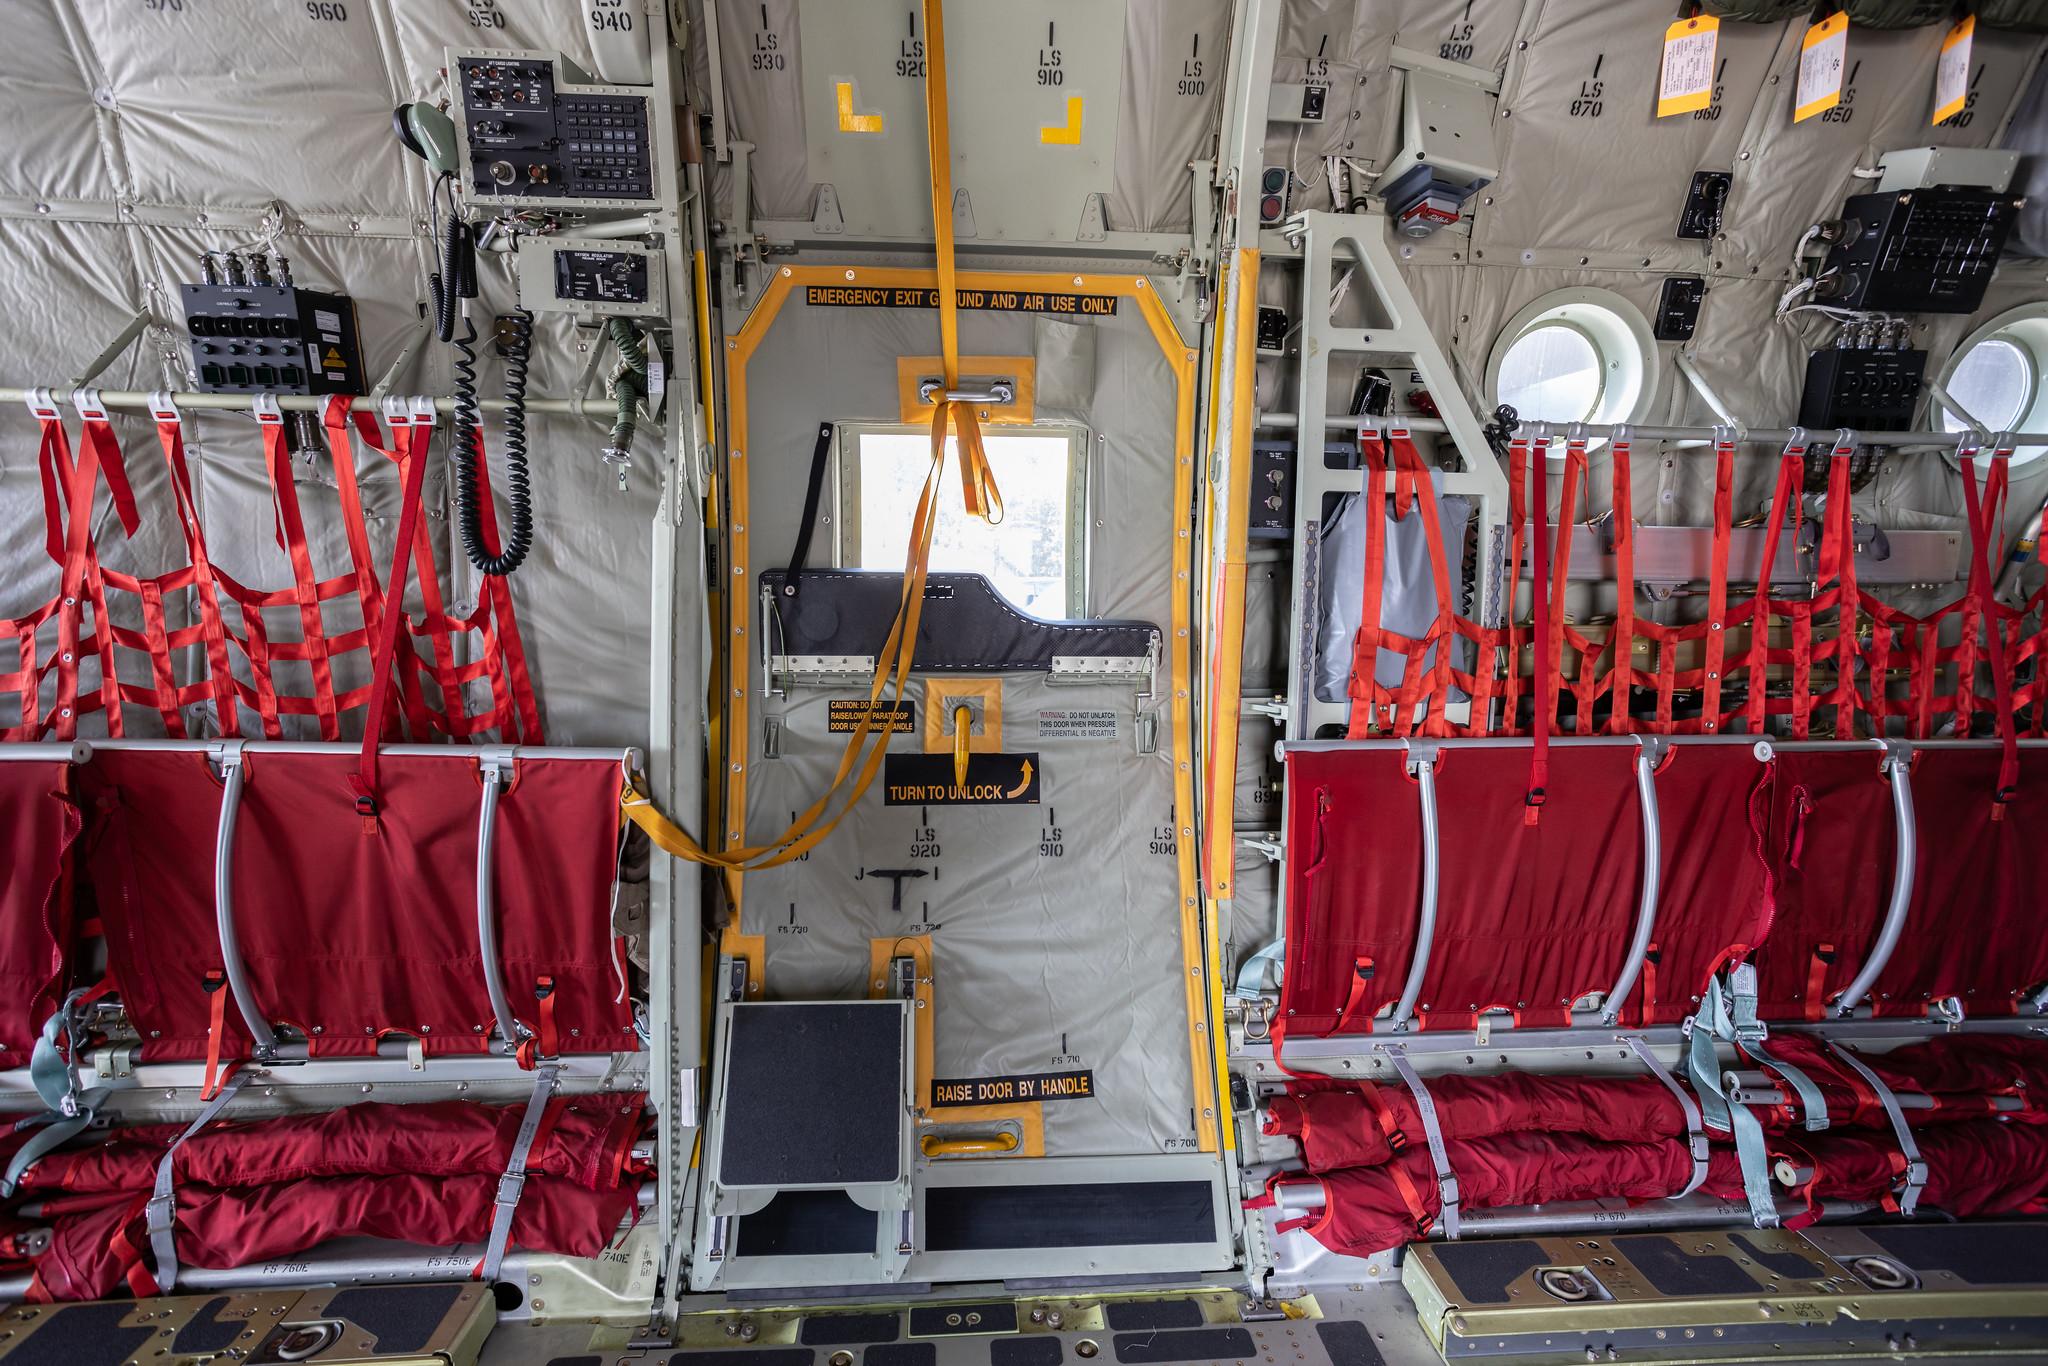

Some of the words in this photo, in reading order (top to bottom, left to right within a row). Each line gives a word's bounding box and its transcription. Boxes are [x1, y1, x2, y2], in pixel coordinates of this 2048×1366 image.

[306, 2, 347, 22] 960
[468, 10, 505, 29] 950
[592, 10, 632, 32] 940
[1450, 25, 1474, 41] LS
[756, 34, 777, 50] LS
[902, 40, 922, 58] LS
[1040, 50, 1061, 66] LS
[1440, 44, 1474, 60] 880
[752, 54, 784, 71] 930
[1184, 61, 1202, 77] LS
[1306, 58, 1328, 76] LS
[1038, 70, 1063, 86] 910
[1178, 81, 1204, 96] 900
[1580, 81, 1604, 98] LS
[1570, 101, 1602, 118] 870
[808, 288, 888, 304] EMERGENCY
[896, 291, 922, 305] EXIT
[930, 292, 984, 307] GUND
[990, 293, 1016, 308] AND
[1024, 294, 1044, 310] AIR
[1051, 296, 1075, 311] USE
[1082, 298, 1114, 313] ONLY
[890, 786, 925, 800] TURN
[928, 786, 944, 800] TO
[949, 784, 1002, 800] UNLOCK
[916, 828, 936, 842] LS
[1042, 828, 1062, 842] LS
[1154, 826, 1172, 840] LS
[910, 844, 940, 858] 920
[1040, 844, 1063, 858] 910
[1150, 842, 1176, 855] 900
[937, 1085, 972, 1102] RAISE
[979, 1082, 1012, 1100] DOOR
[1019, 1081, 1034, 1097] BY
[1042, 1076, 1088, 1095] HANDLE
[1164, 1139, 1176, 1148] FS
[1180, 1138, 1196, 1147] 700
[1594, 1212, 1606, 1221] FS
[1609, 1212, 1626, 1220] 670
[427, 1256, 442, 1267] FS
[446, 1256, 472, 1266] 750E
[603, 1251, 630, 1264] 740E
[263, 1264, 278, 1274] FS
[282, 1262, 311, 1272] 760E
